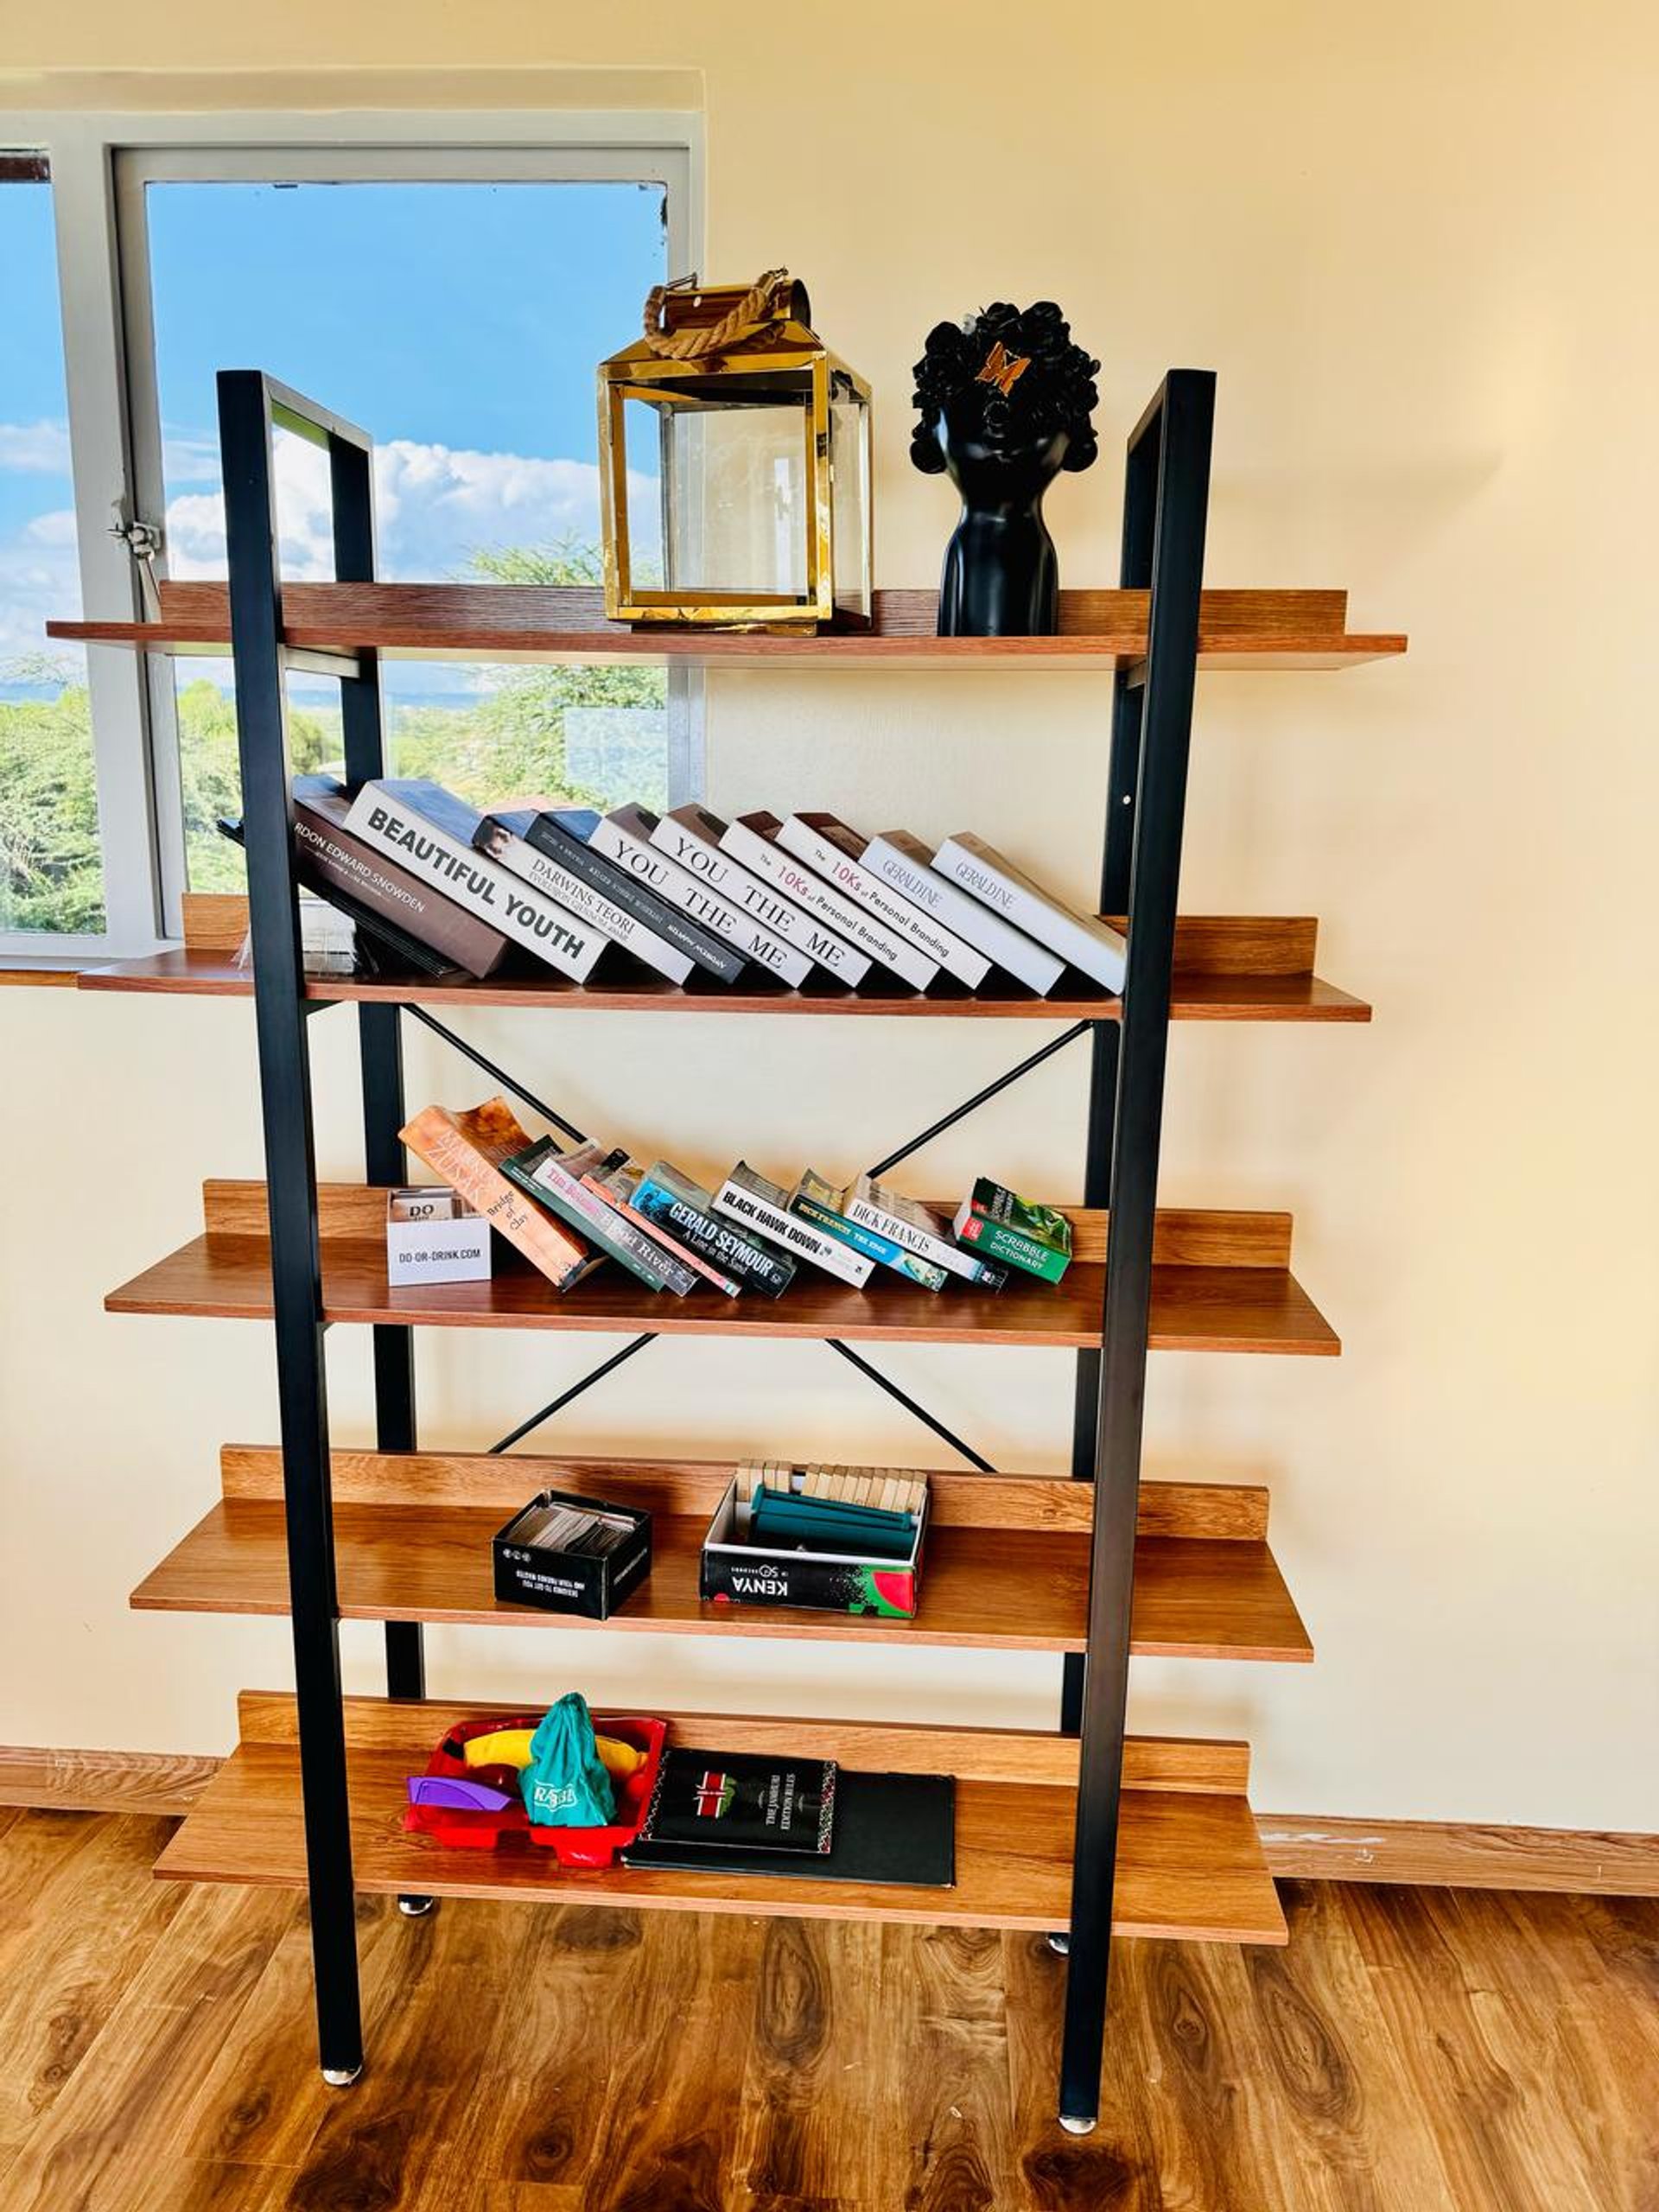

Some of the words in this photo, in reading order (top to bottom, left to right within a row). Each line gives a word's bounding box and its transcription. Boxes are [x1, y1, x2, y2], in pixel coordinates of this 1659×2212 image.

[294, 823, 327, 848] RDON
[326, 842, 372, 877] EDWARD
[372, 873, 426, 913] SNOWDEN
[367, 806, 497, 906] BEAUTIFUL
[504, 893, 585, 959] YOUTH
[532, 859, 595, 906] DARWINS
[596, 900, 637, 934] TEORI
[882, 860, 944, 907] GERALDINE
[956, 861, 1017, 910] GERALDINE
[614, 838, 669, 887] YOU
[683, 887, 738, 934] THE
[747, 934, 787, 969] ME
[675, 837, 728, 885] YOU
[745, 885, 796, 932] THE
[805, 932, 846, 968] ME
[760, 854, 772, 866] The
[778, 866, 809, 896] 10Ks
[816, 897, 858, 930] Personal
[857, 925, 898, 962] Branding
[815, 849, 826, 861] The
[832, 861, 862, 892] 10Ks
[868, 891, 912, 925] Personal
[910, 921, 950, 958] Branding
[409, 1205, 435, 1217] DO
[486, 1191, 515, 1216] Bridge
[510, 1214, 528, 1230] Clay
[722, 1191, 758, 1218] BLACK
[755, 1210, 790, 1236] HAWK
[787, 1227, 822, 1254] DOWN
[853, 1205, 881, 1228] DICK
[880, 1217, 931, 1252] FRANCIS
[602, 1213, 639, 1247] Blood
[638, 1236, 673, 1275] River
[669, 1202, 719, 1240] GERALD
[715, 1230, 773, 1277] SEYMOUR
[990, 1242, 1044, 1269] DICTIONARY
[995, 1230, 1050, 1262] SCRABBLE
[732, 1576, 788, 1596] KENYA
